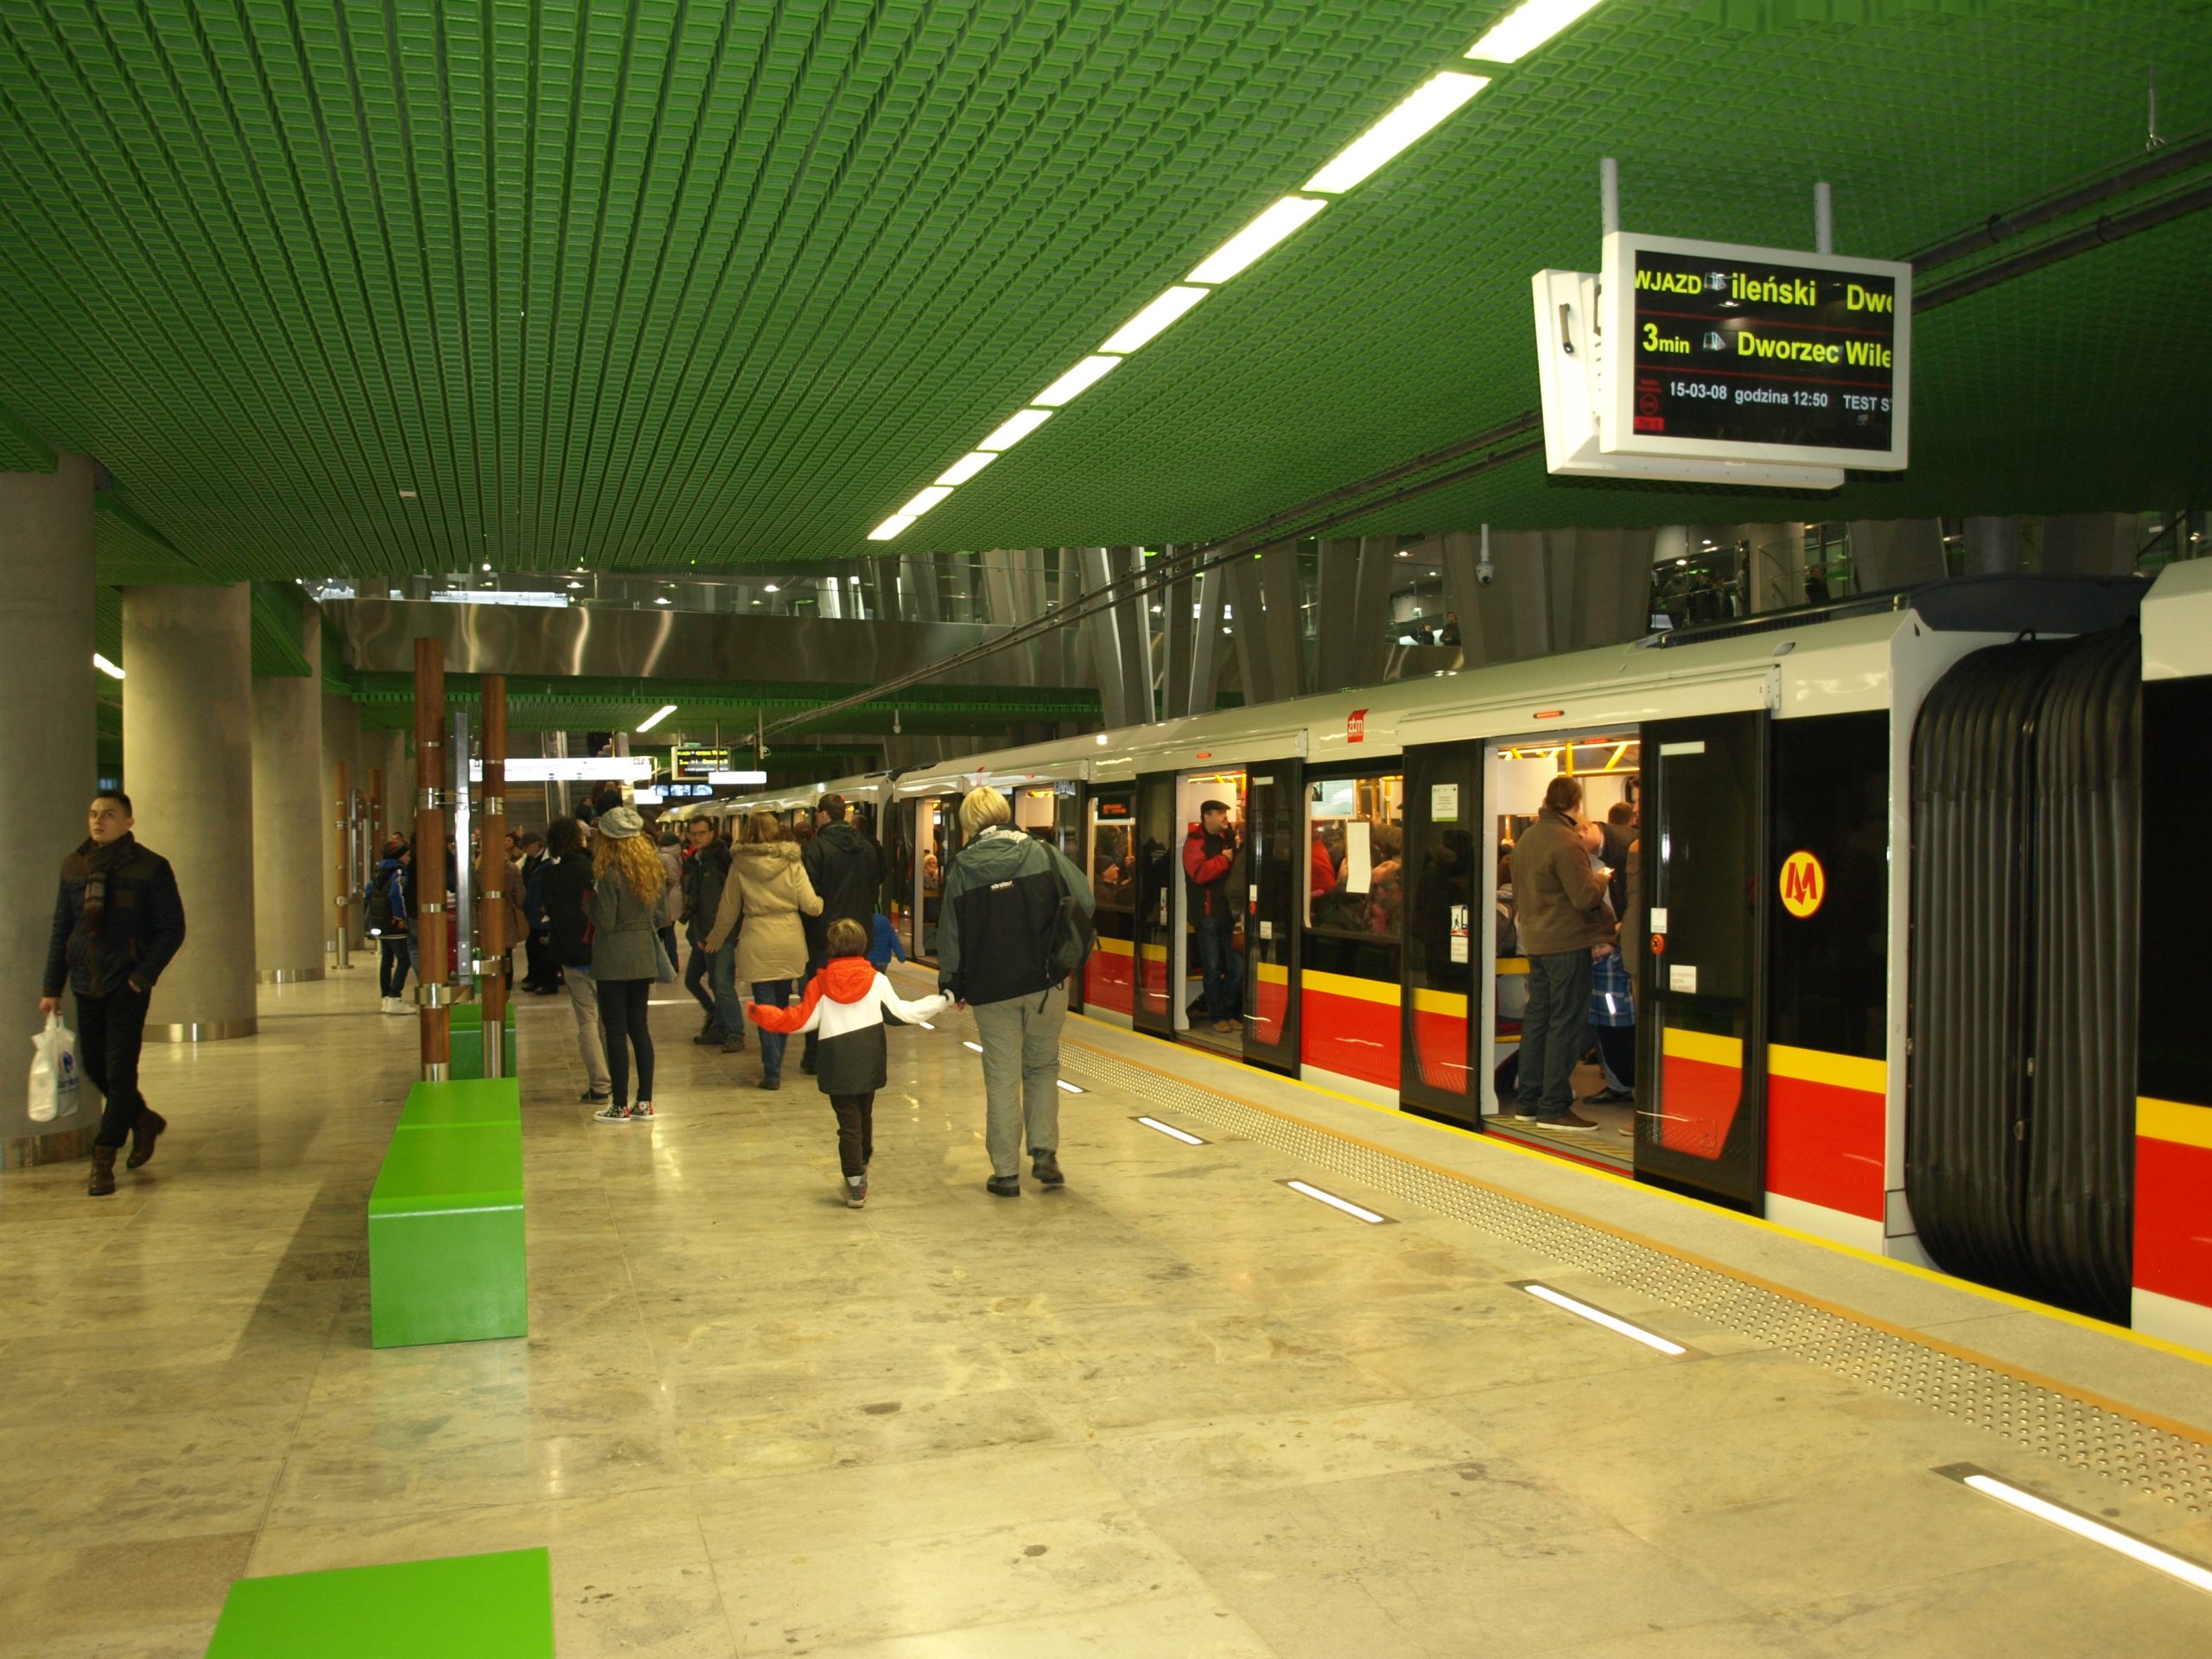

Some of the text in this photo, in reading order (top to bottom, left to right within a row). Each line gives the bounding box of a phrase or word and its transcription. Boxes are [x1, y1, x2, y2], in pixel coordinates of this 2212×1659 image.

[1634, 270, 1702, 295] WJAZD
[1738, 331, 1839, 363] Dworzec
[1670, 381, 1727, 400] 15-03-08
[1734, 388, 1789, 405] godzina
[1793, 391, 1827, 407] 12:50
[1843, 394, 1877, 410] TEST
[1881, 397, 1892, 412] S
